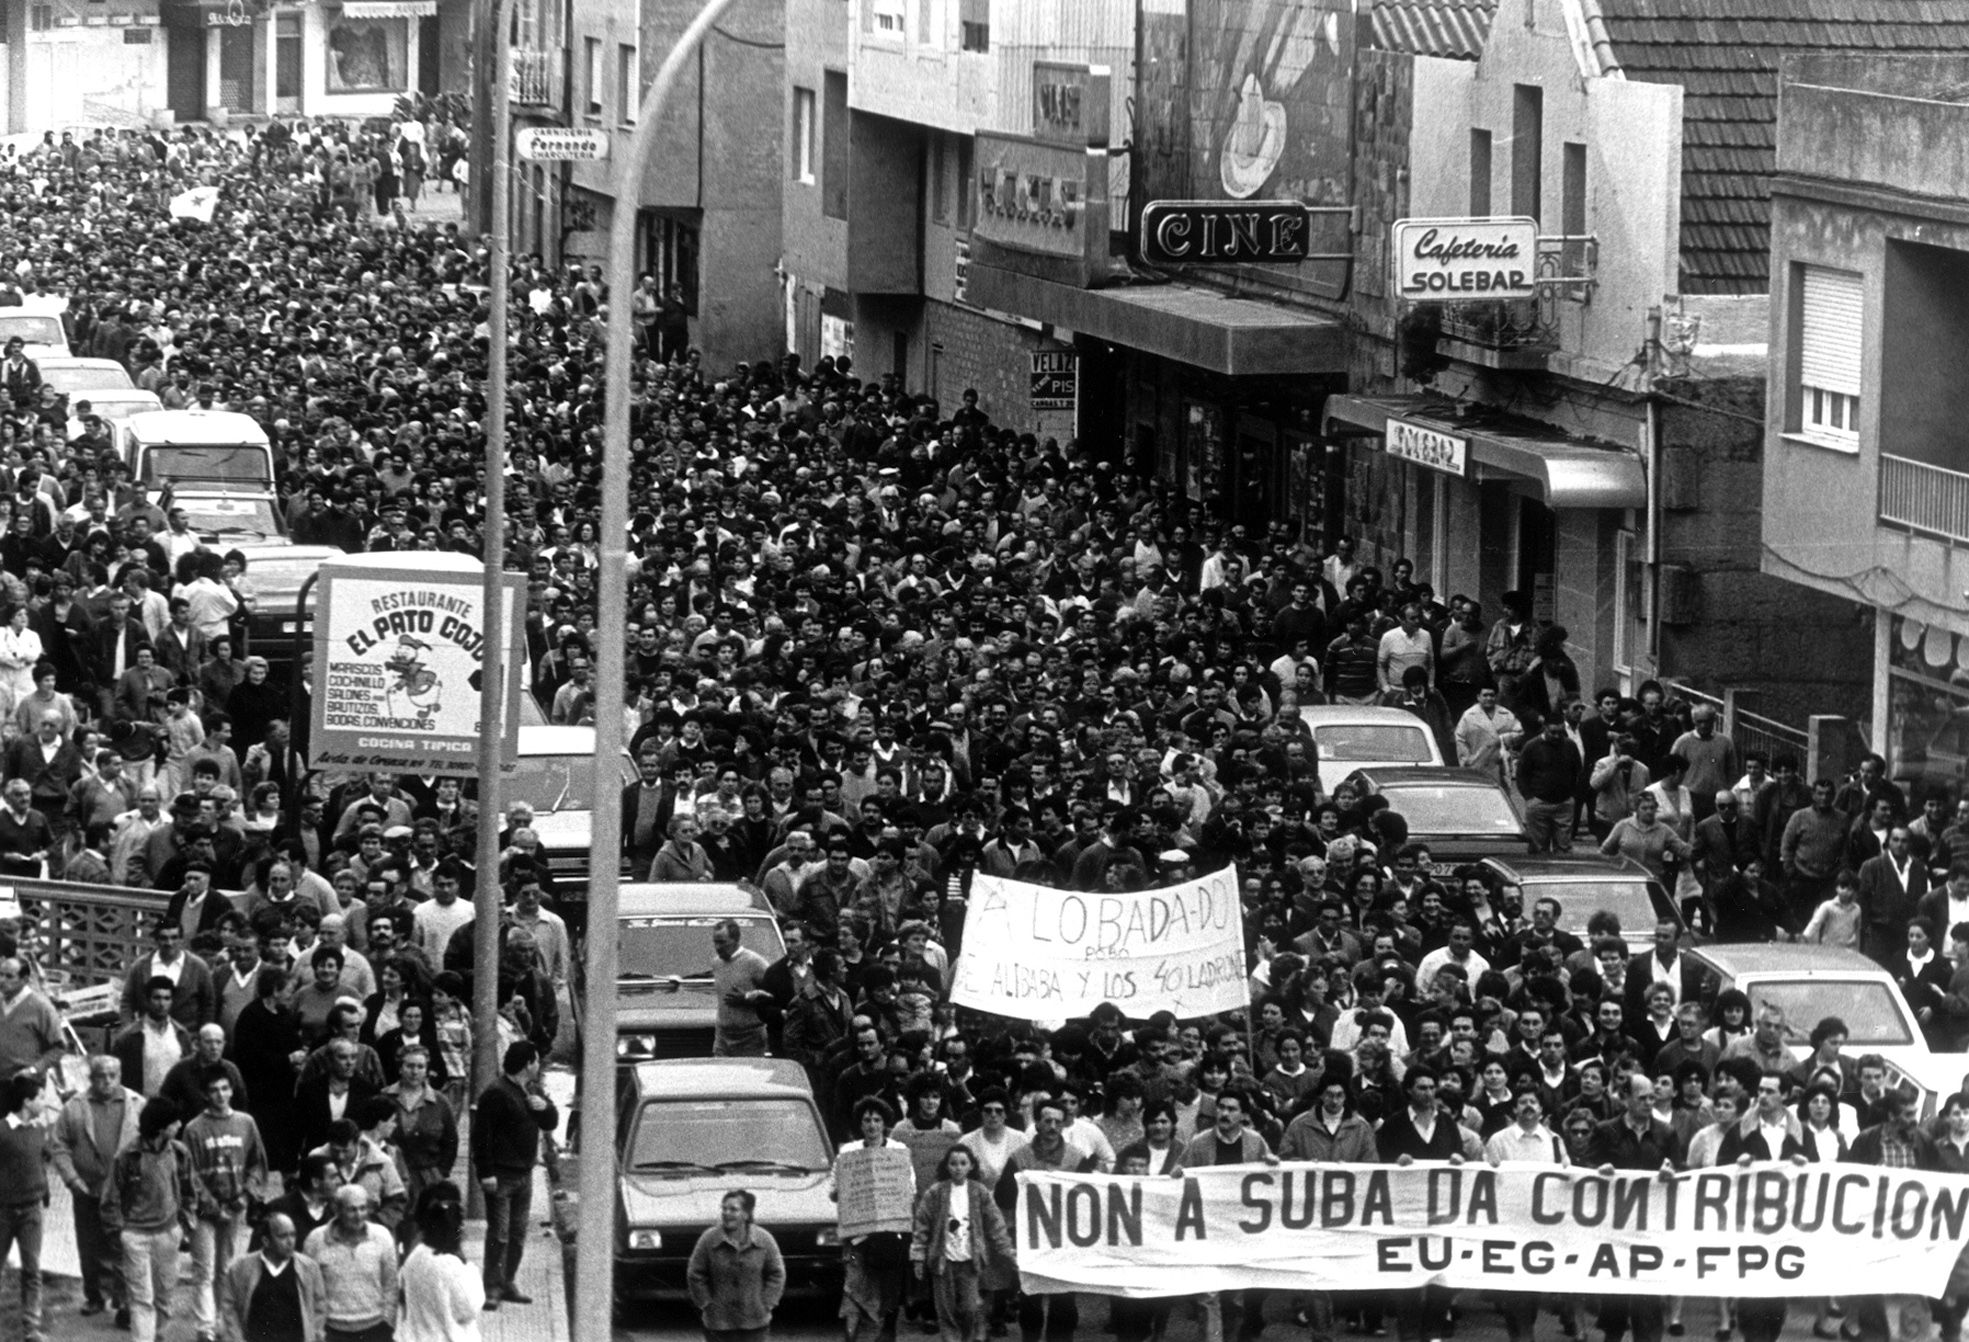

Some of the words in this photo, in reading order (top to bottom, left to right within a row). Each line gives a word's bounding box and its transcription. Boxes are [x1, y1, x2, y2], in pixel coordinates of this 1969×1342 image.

[1157, 213, 1303, 257] CINE
[1414, 228, 1521, 266] Cafeteria
[1403, 270, 1534, 292] SOLEBAR
[1032, 353, 1076, 371] VELAZ
[370, 591, 473, 619] RESTAURANTE
[346, 629, 378, 657] EL
[373, 609, 435, 640] PATO
[328, 674, 385, 689] COCHINILLO
[329, 662, 383, 676] MARISCOS
[327, 687, 371, 701] SALONES
[363, 715, 436, 731] CONVENCIONES
[358, 736, 416, 750] COCINA
[421, 739, 473, 752] TIPICA
[1077, 970, 1092, 999] Y
[1103, 970, 1137, 999] LOS
[1026, 1182, 1143, 1249] NON
[1174, 1177, 1207, 1242] A
[1238, 1169, 1395, 1234] SUBA
[1427, 1169, 1498, 1226] DA
[1377, 1237, 1805, 1280] EU-EG-AP-FPG
